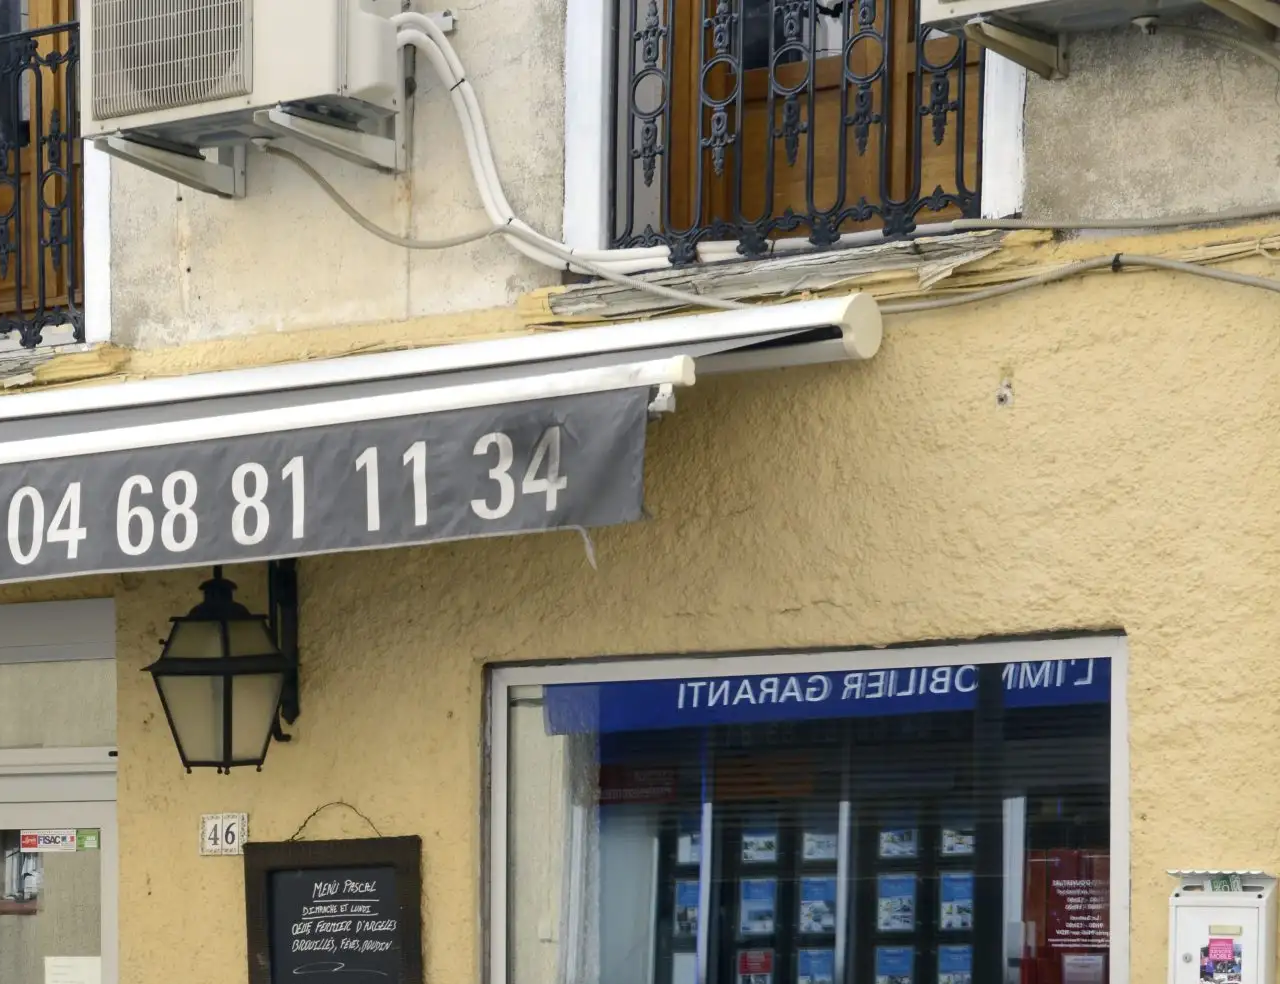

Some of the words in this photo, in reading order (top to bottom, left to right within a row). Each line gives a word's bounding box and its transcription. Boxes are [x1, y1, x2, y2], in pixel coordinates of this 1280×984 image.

[7, 482, 87, 565] 04
[116, 470, 199, 555] 68
[231, 455, 305, 545] 81
[355, 440, 426, 532] 11
[471, 425, 568, 520] 34
[38, 835, 60, 845] FISAC
[208, 822, 236, 846] 46
[343, 879, 376, 893] PASCAL
[302, 904, 337, 916] DIMANCHE
[340, 904, 349, 912] ET
[350, 905, 372, 913] LUNDI
[315, 920, 352, 933] FERMIER
